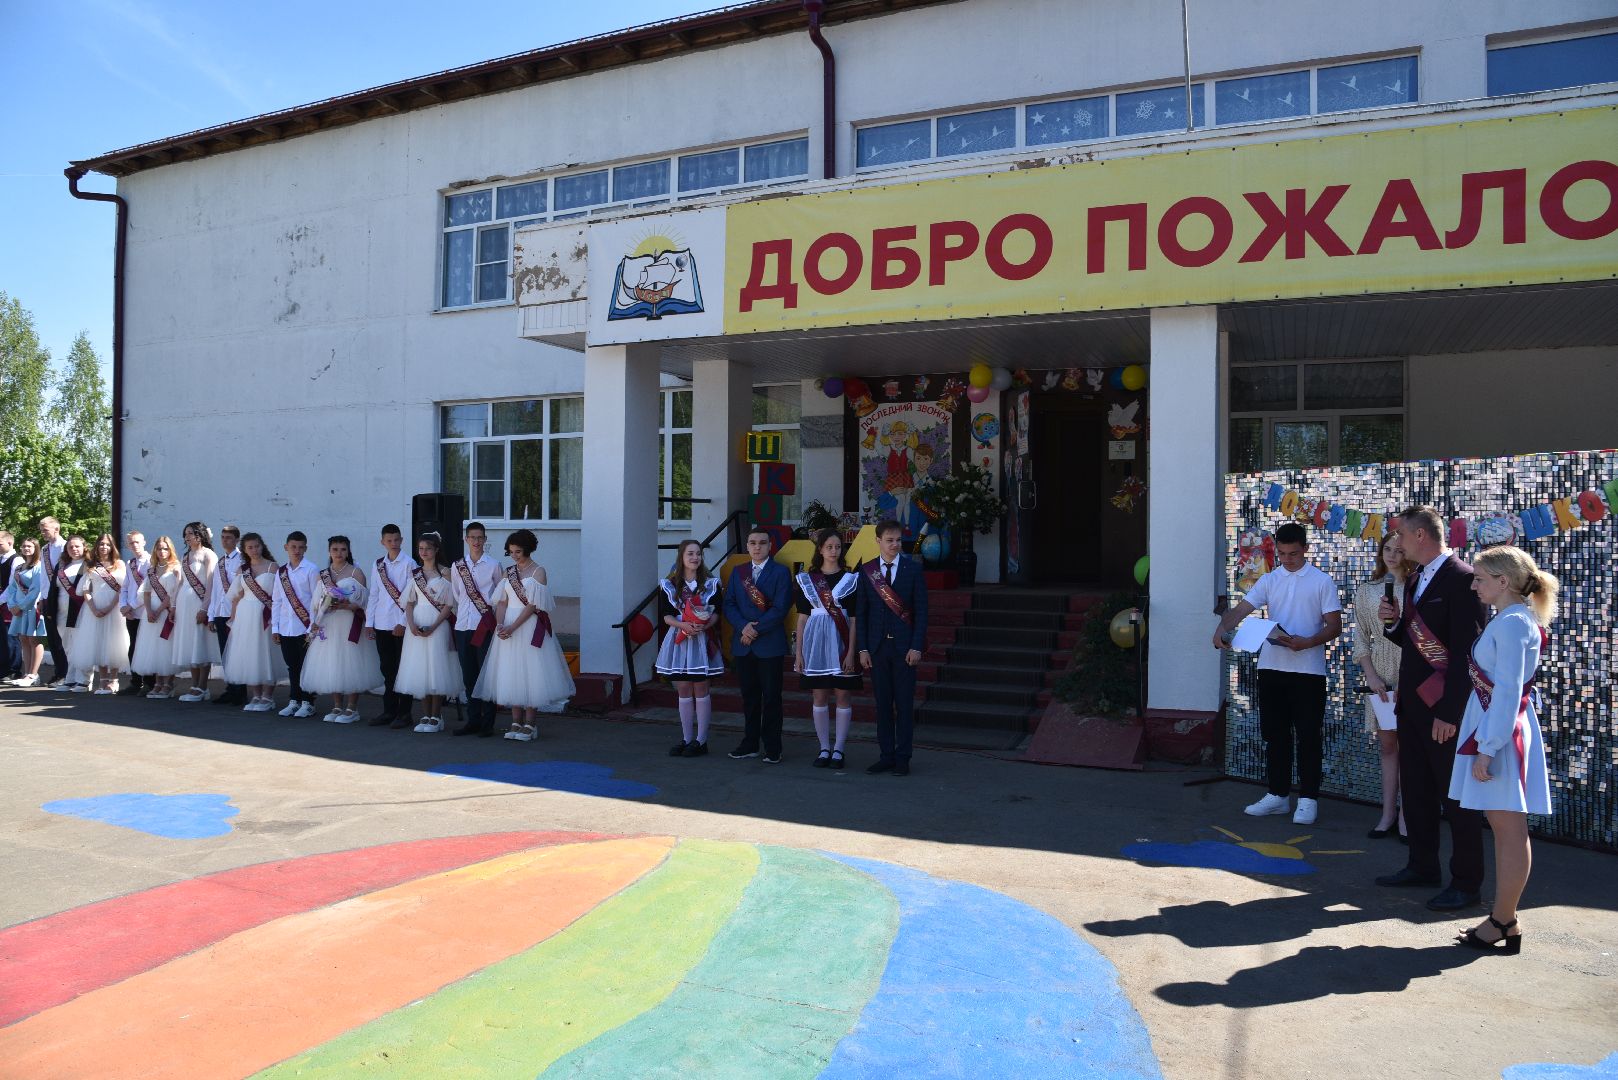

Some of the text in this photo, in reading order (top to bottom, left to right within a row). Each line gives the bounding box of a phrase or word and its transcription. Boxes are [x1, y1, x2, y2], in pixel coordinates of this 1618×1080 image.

[739, 159, 1618, 313] ДОБРО ПОЖАЛО
[860, 402, 951, 431] ПОСЛЕДНИЙ ЗВОНОК
